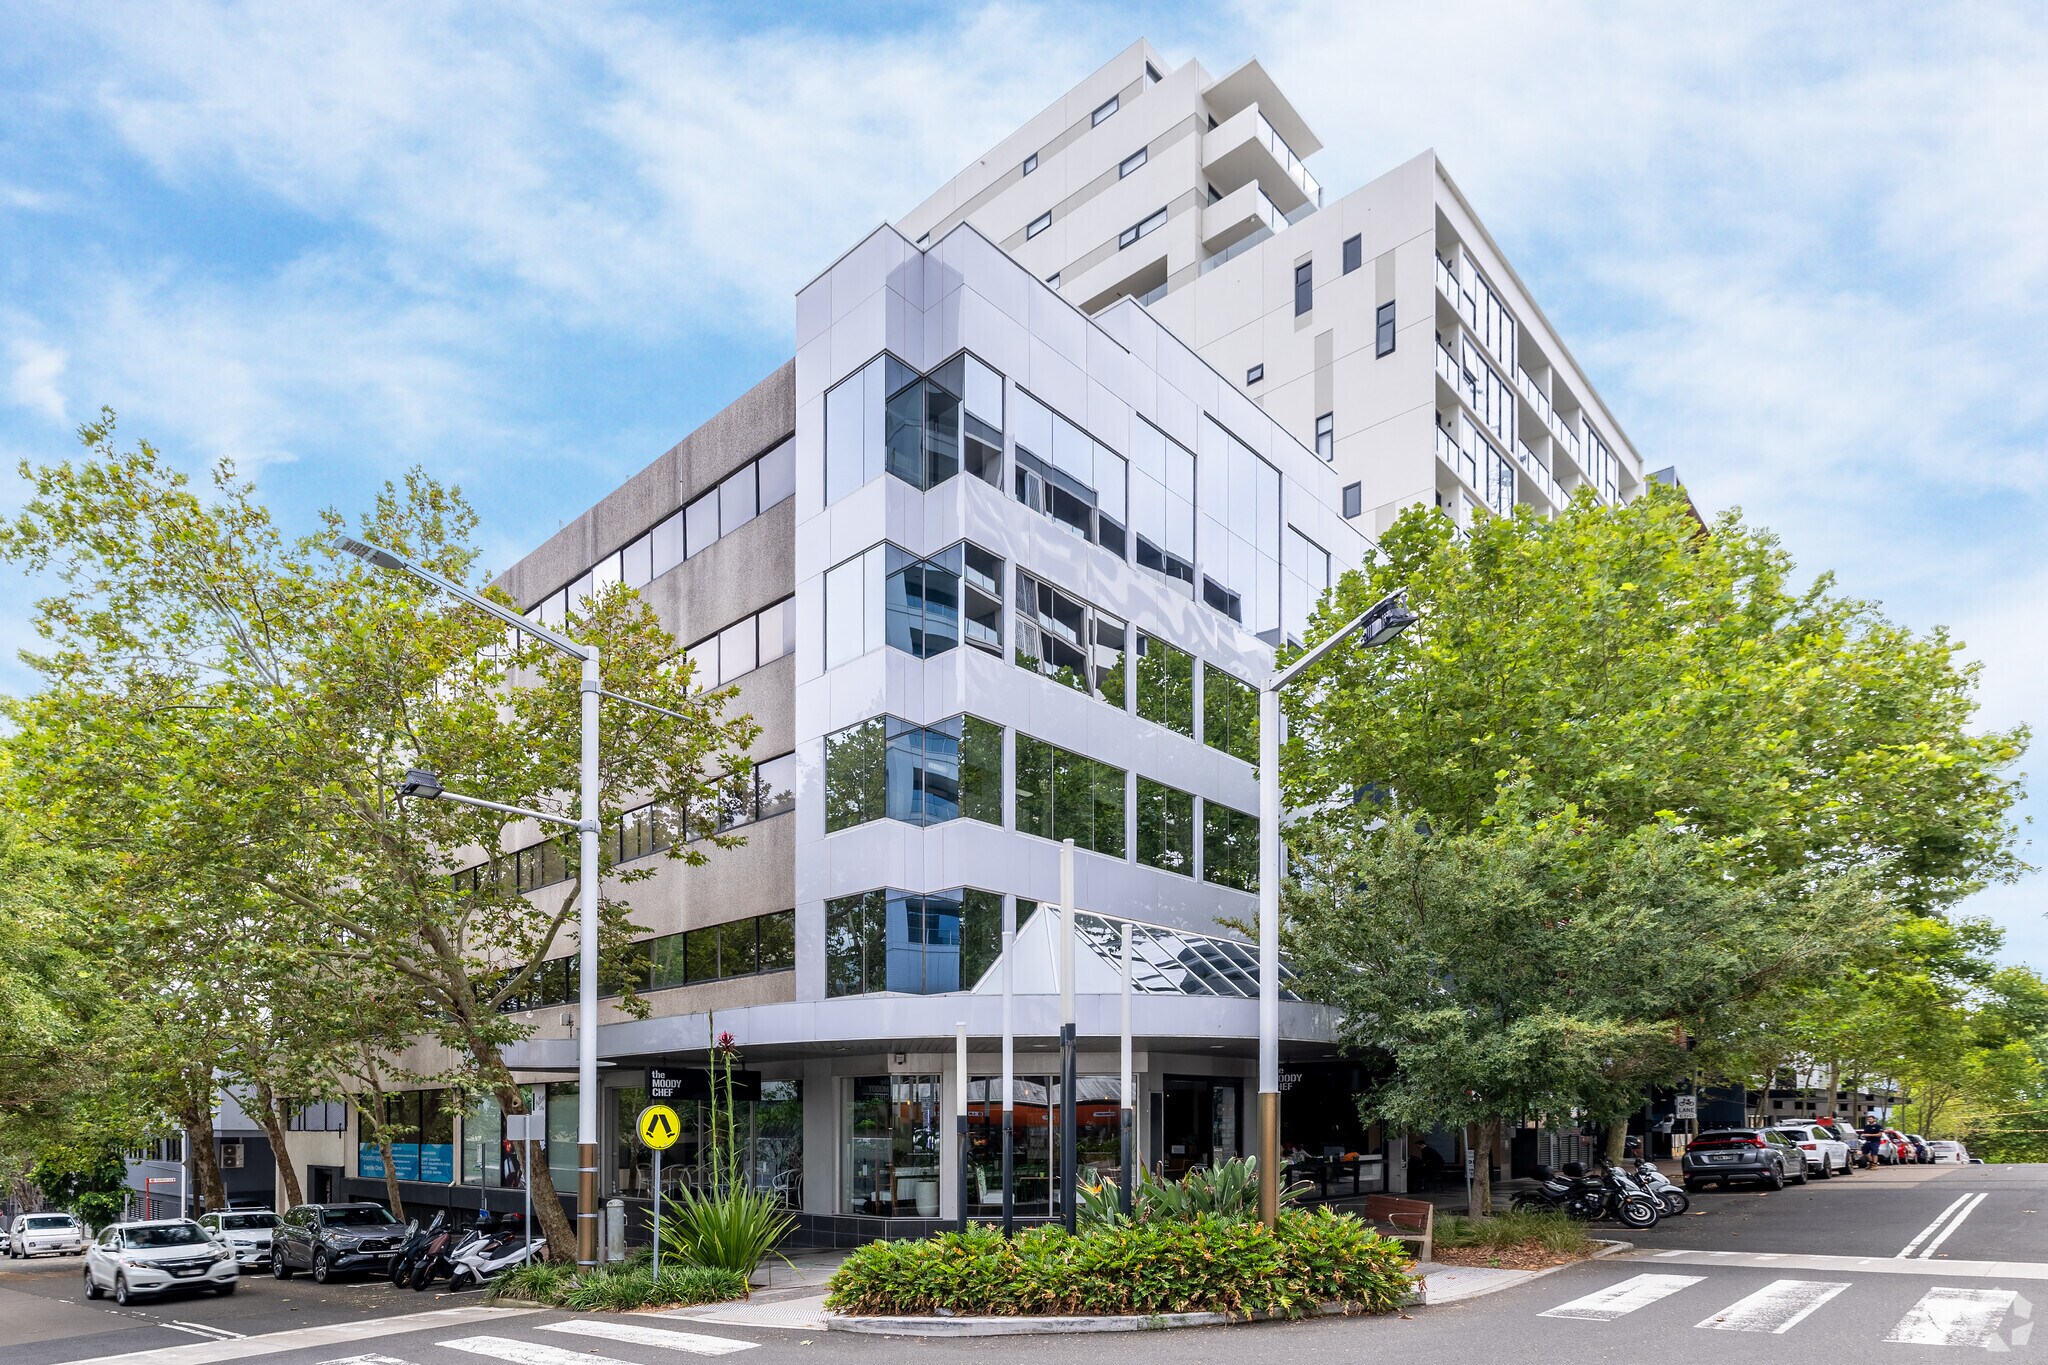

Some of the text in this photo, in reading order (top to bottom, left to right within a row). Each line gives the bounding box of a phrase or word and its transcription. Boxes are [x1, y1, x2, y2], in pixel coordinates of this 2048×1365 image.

[651, 1070, 666, 1079] the
[1278, 1073, 1303, 1083] OODY
[652, 1079, 682, 1088] MOODY
[1278, 1082, 1293, 1091] HEF
[652, 1088, 674, 1097] CHEF
